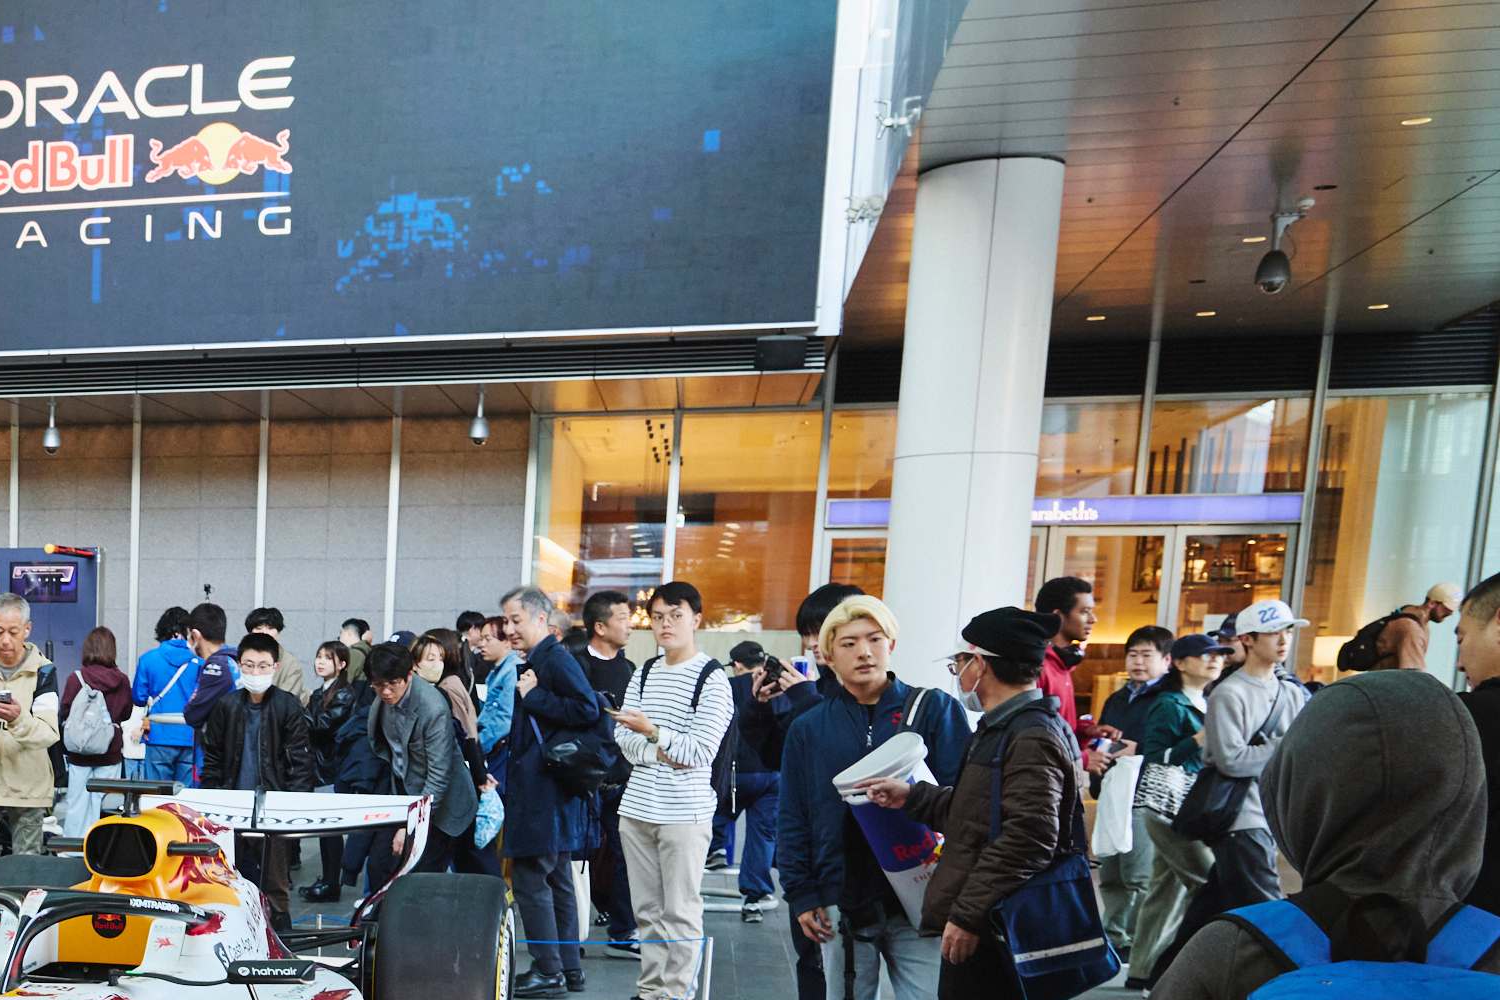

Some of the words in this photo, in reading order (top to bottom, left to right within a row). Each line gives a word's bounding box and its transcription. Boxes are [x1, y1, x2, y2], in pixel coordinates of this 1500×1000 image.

[45, 134, 134, 193] Bull
[1258, 607, 1279, 624] 22
[252, 966, 297, 976] hahnair
